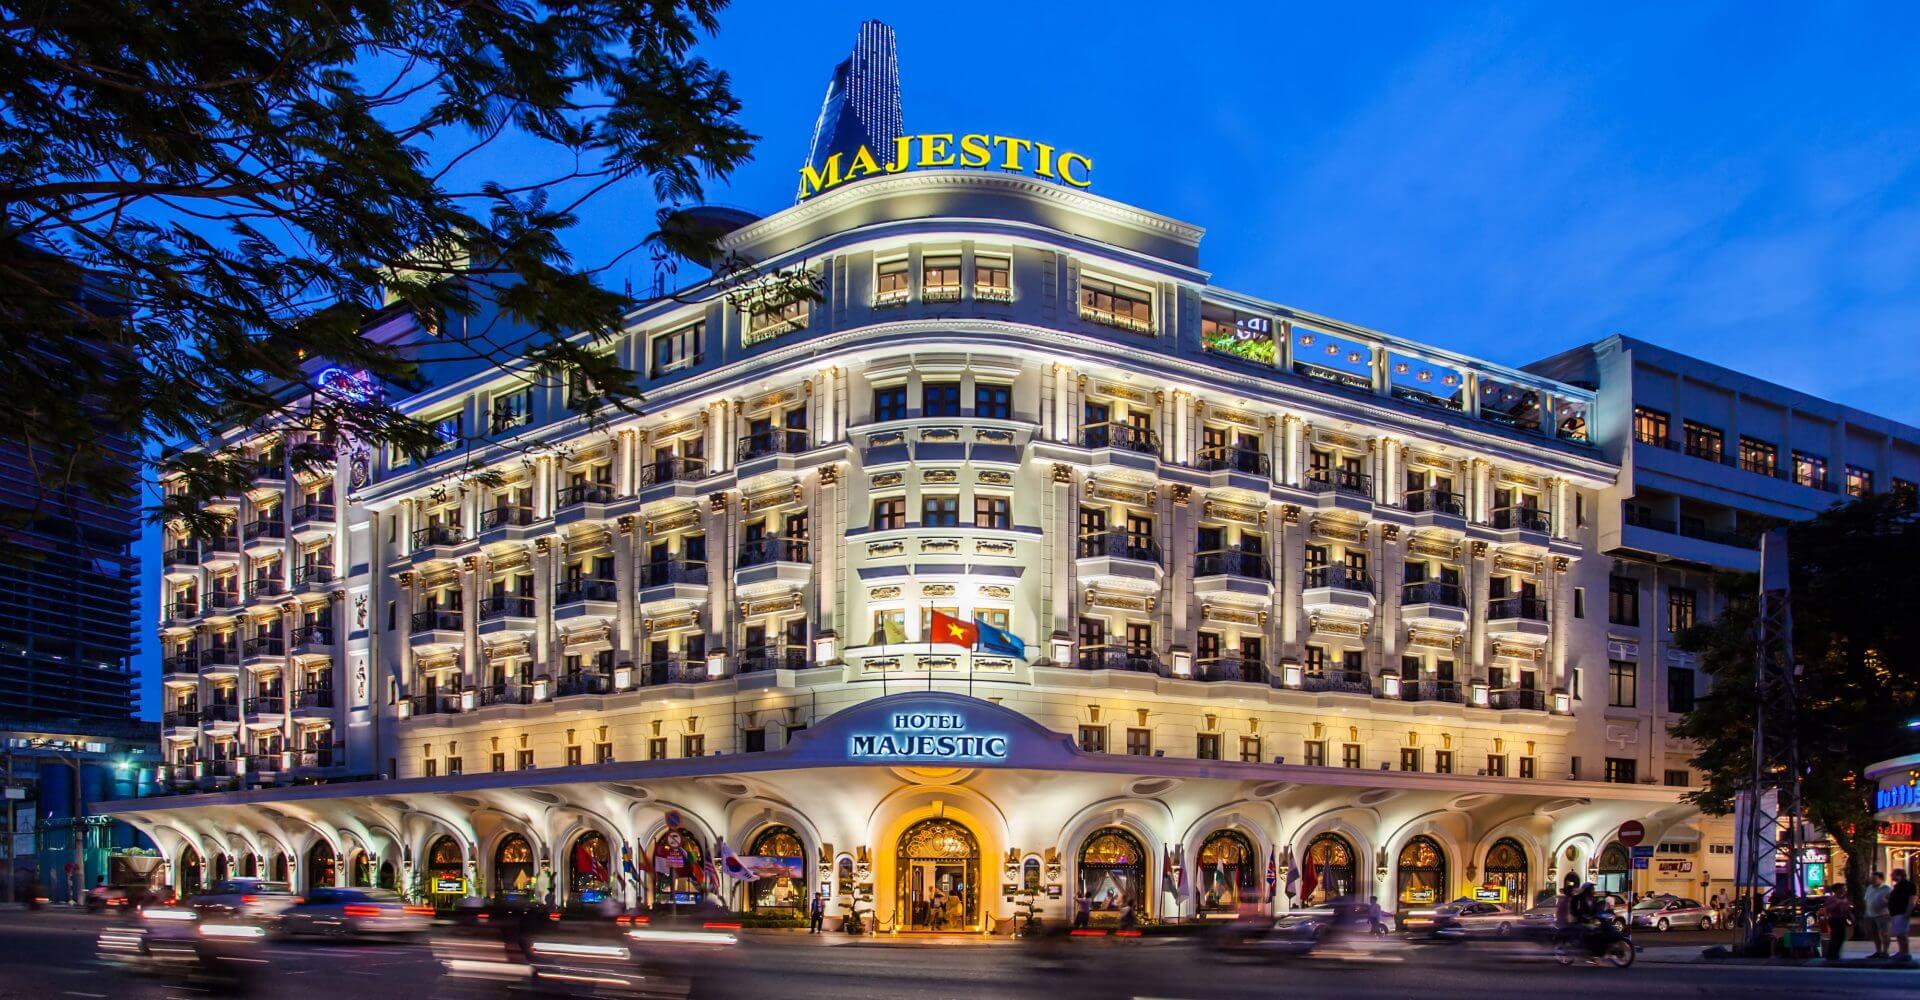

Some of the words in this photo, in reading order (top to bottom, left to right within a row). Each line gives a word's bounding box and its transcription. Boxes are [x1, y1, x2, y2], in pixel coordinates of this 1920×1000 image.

[799, 133, 1092, 198] MAJESTIC
[894, 715, 964, 729] HOTEL
[852, 735, 1007, 757] MAJESTIC
